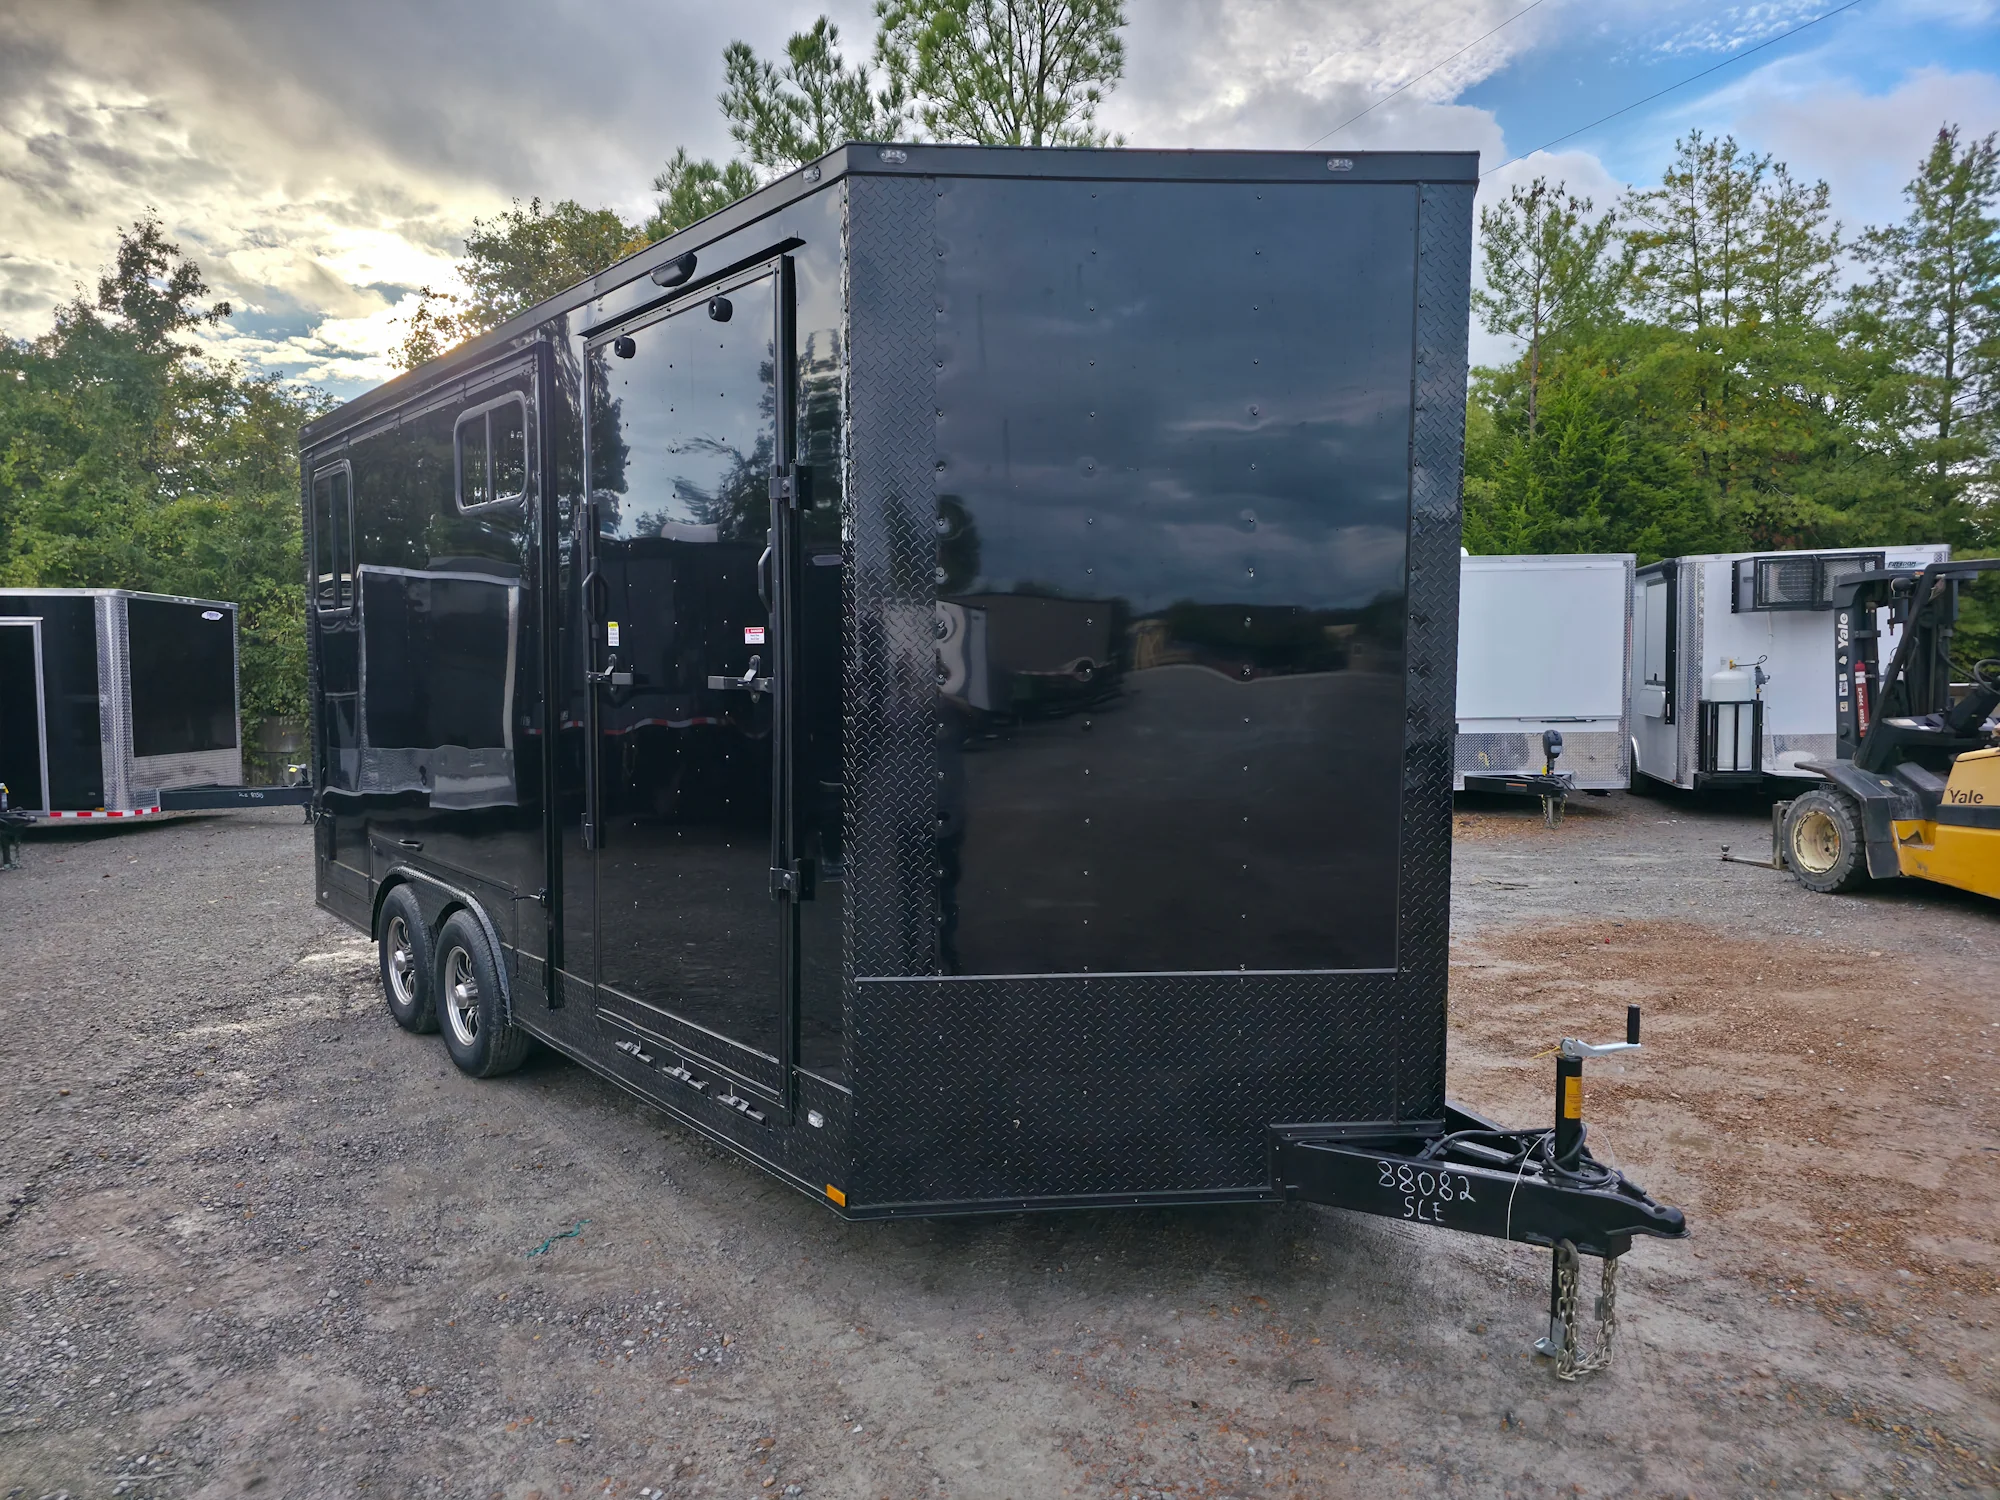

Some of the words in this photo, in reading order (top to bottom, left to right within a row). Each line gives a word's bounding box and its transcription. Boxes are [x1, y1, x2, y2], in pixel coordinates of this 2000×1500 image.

[1838, 613, 1849, 649] Yale
[1950, 789, 1984, 804] Yale
[1377, 1160, 1477, 1203] 88082
[1403, 1195, 1446, 1221] SLE
